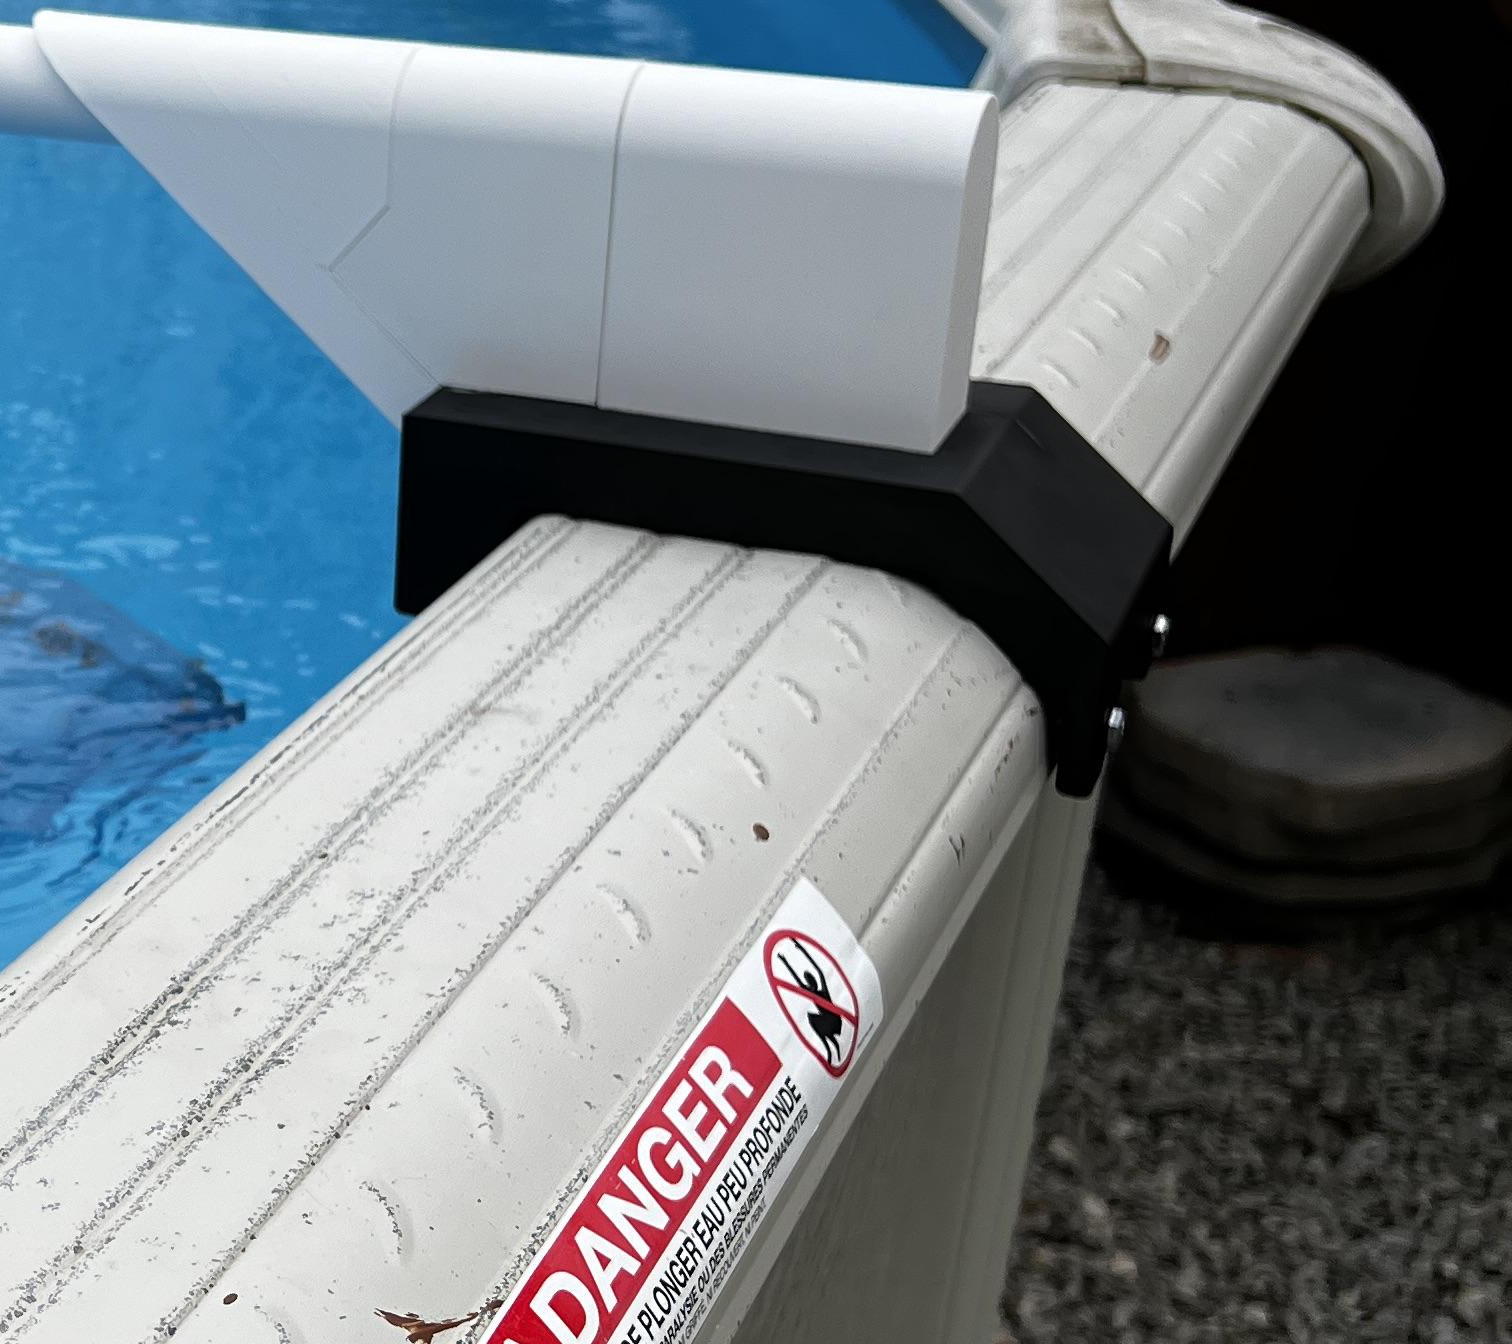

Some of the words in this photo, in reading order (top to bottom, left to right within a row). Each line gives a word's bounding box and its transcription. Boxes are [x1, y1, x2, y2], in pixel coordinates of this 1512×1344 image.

[637, 1237, 703, 1341] PLONGER
[692, 1197, 725, 1251] EAU
[716, 1161, 747, 1212] PEU
[739, 1076, 801, 1176] PROFONDE
[698, 1267, 710, 1293] OU
[709, 1242, 725, 1273] DES
[724, 1178, 763, 1250] BLESSURES
